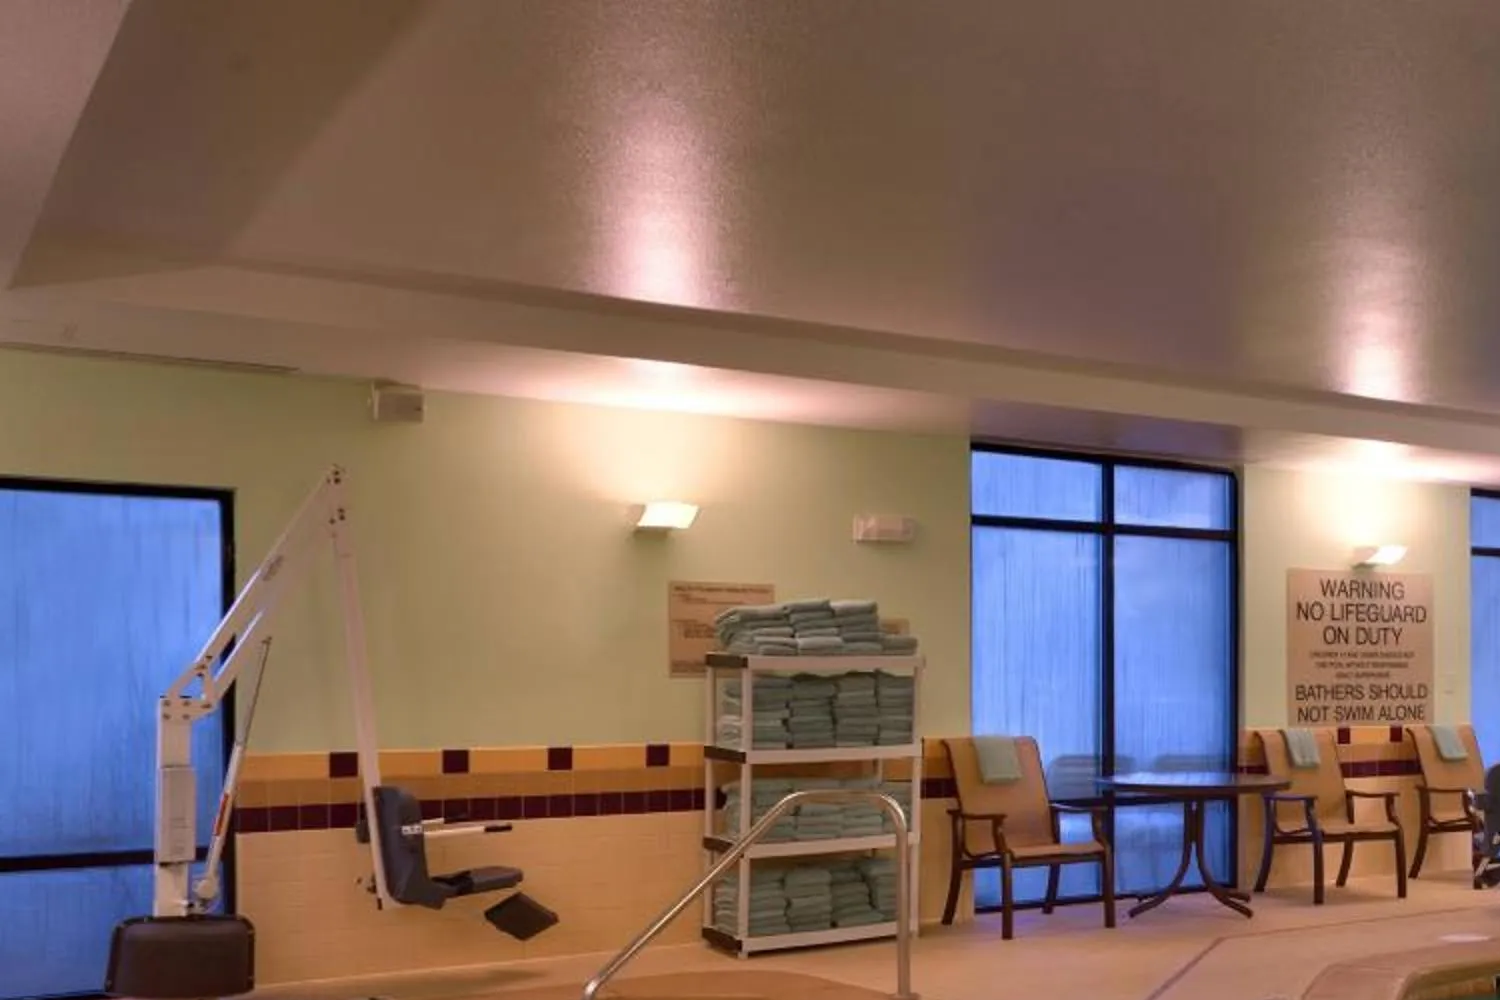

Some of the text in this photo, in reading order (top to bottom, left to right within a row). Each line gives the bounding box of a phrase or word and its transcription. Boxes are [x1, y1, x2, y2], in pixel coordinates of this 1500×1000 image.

[1319, 578, 1405, 601] WARNING
[1296, 601, 1427, 624] NO LIFEGUARD
[1322, 625, 1403, 646] ON DUTY
[1295, 683, 1428, 702] BATHERS SHOULD
[1297, 704, 1426, 723] NOT SWIM ALONE
